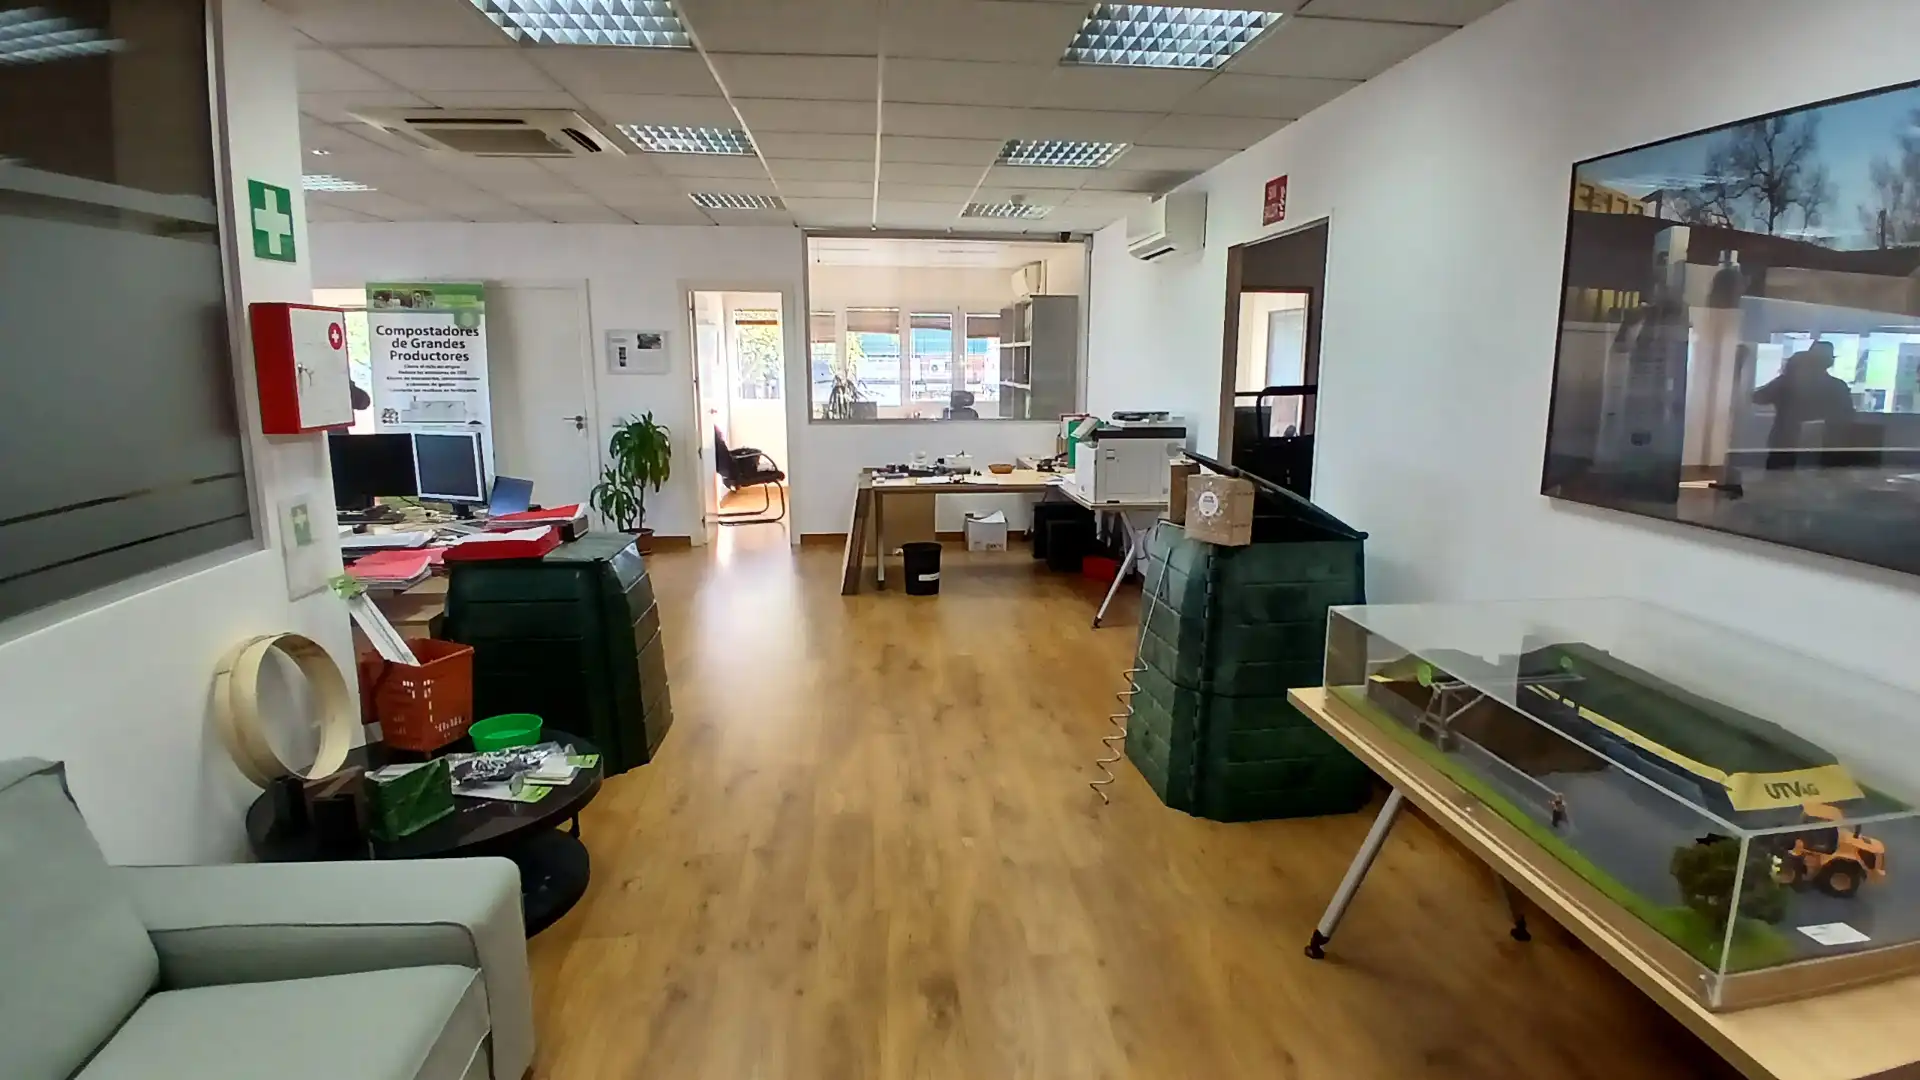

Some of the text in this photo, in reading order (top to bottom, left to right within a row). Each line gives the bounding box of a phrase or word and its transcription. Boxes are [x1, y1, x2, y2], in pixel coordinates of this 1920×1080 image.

[376, 325, 479, 338] Compostadores
[392, 338, 466, 349] de Grandes
[390, 350, 470, 361] Productores
